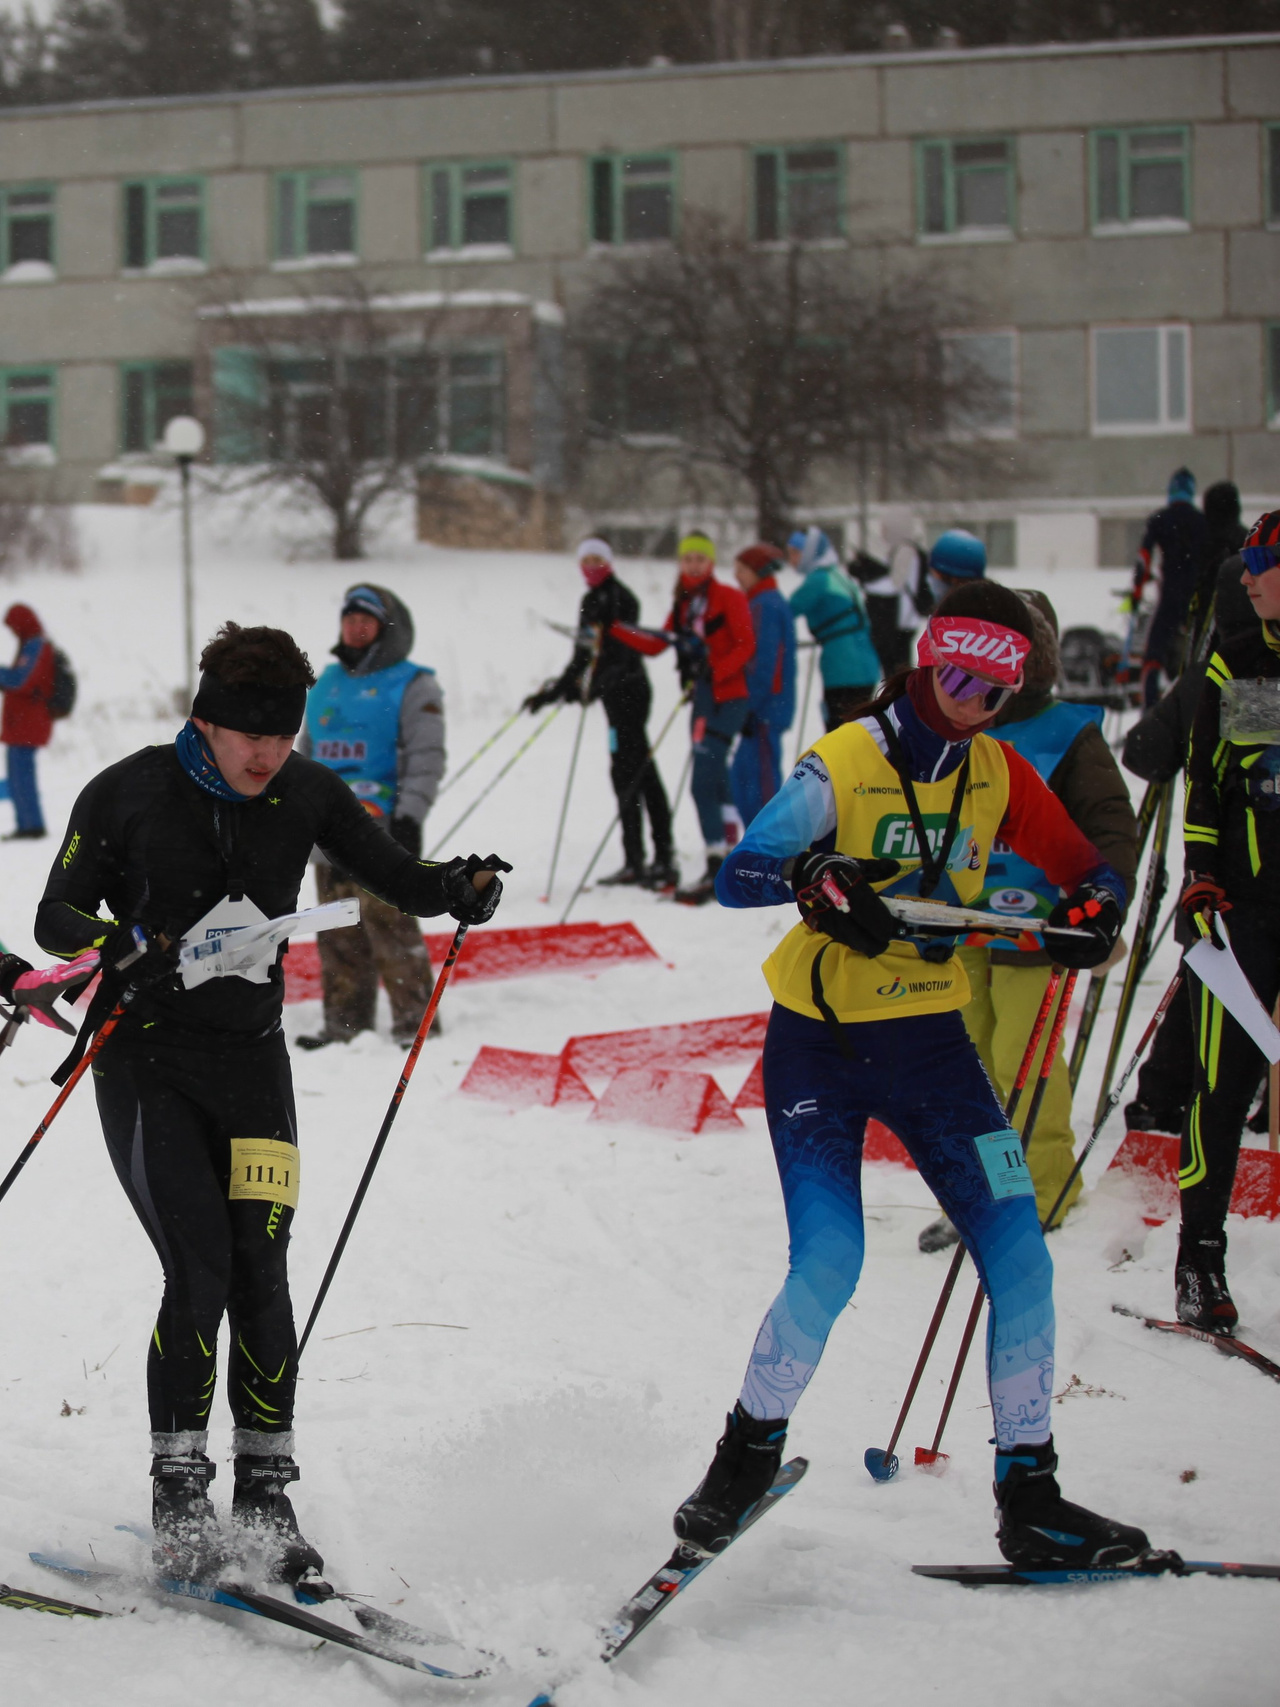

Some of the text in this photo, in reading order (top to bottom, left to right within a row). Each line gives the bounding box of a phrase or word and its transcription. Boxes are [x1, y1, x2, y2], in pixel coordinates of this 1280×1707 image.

[244, 1165, 290, 1188] 111.1
[162, 1465, 207, 1475] SPINE
[251, 1469, 292, 1479] SPINE
